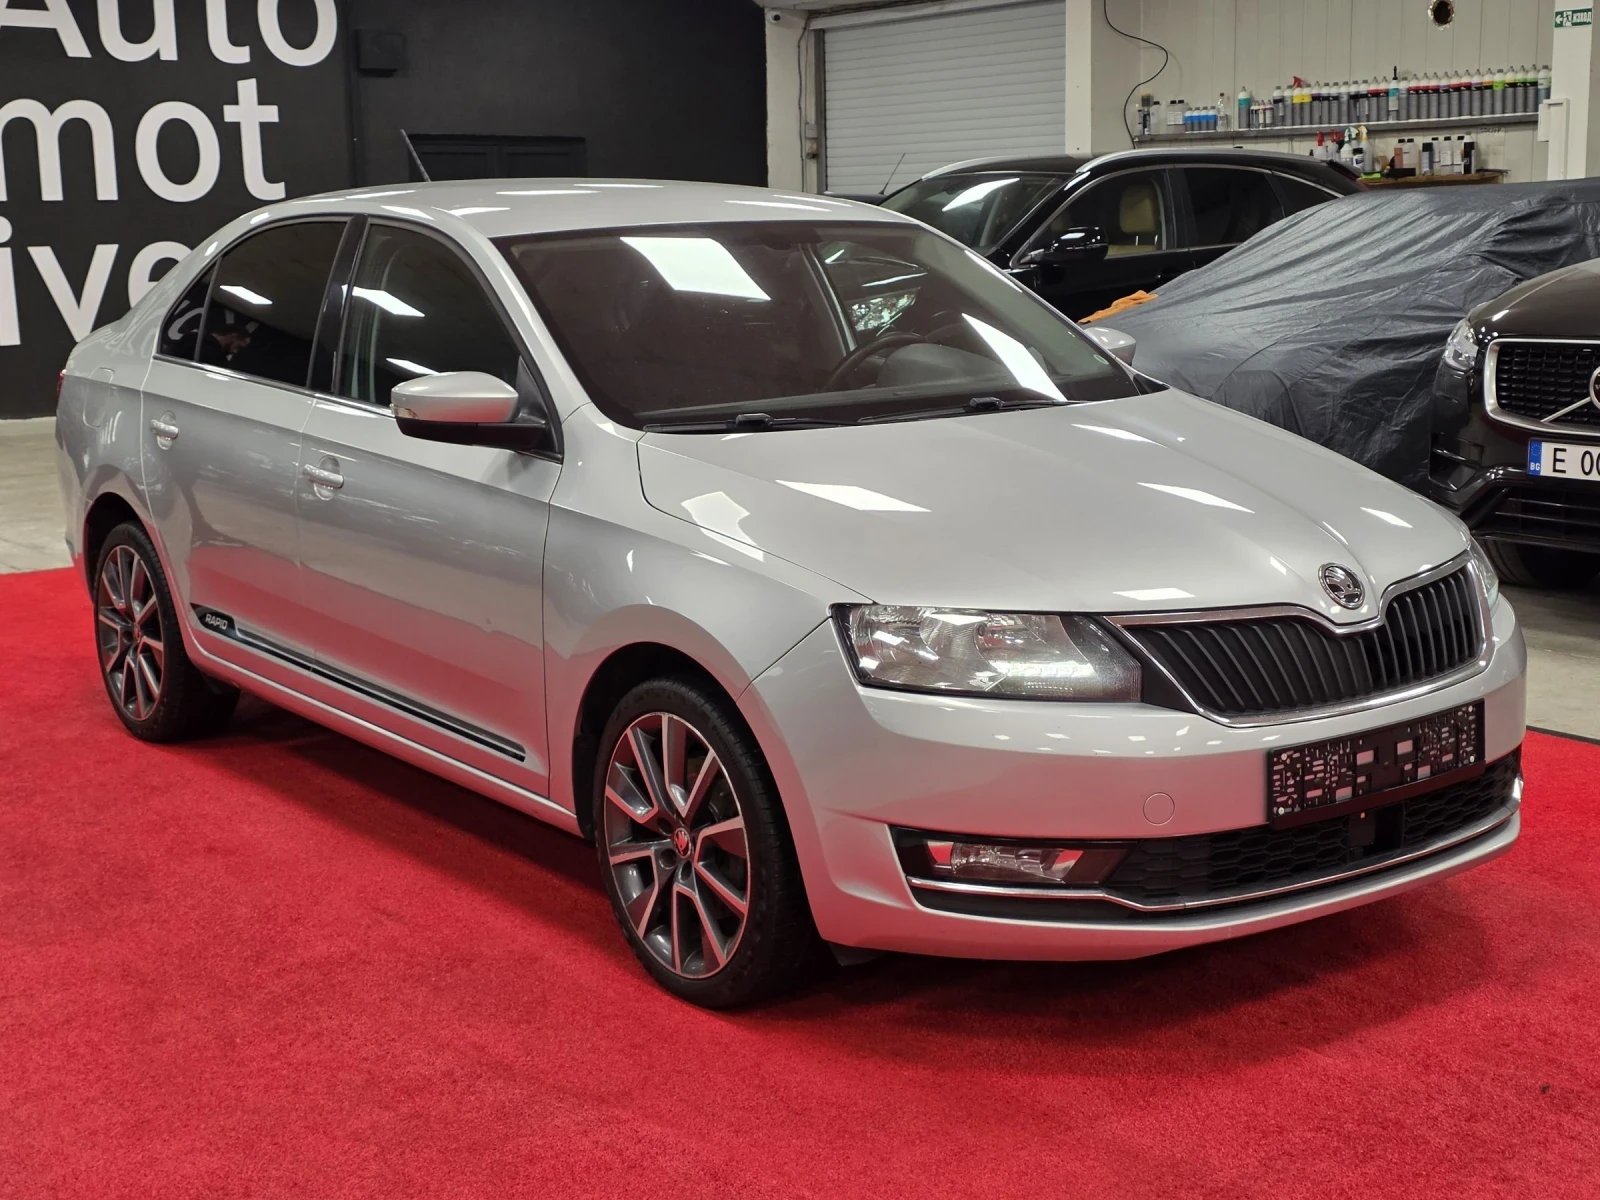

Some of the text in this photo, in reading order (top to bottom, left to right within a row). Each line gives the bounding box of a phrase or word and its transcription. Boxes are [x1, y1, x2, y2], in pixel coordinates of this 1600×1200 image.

[0, 78, 286, 202] mot
[1530, 462, 1541, 471] BG
[1552, 447, 1567, 474] E
[205, 613, 228, 630] RAPID
